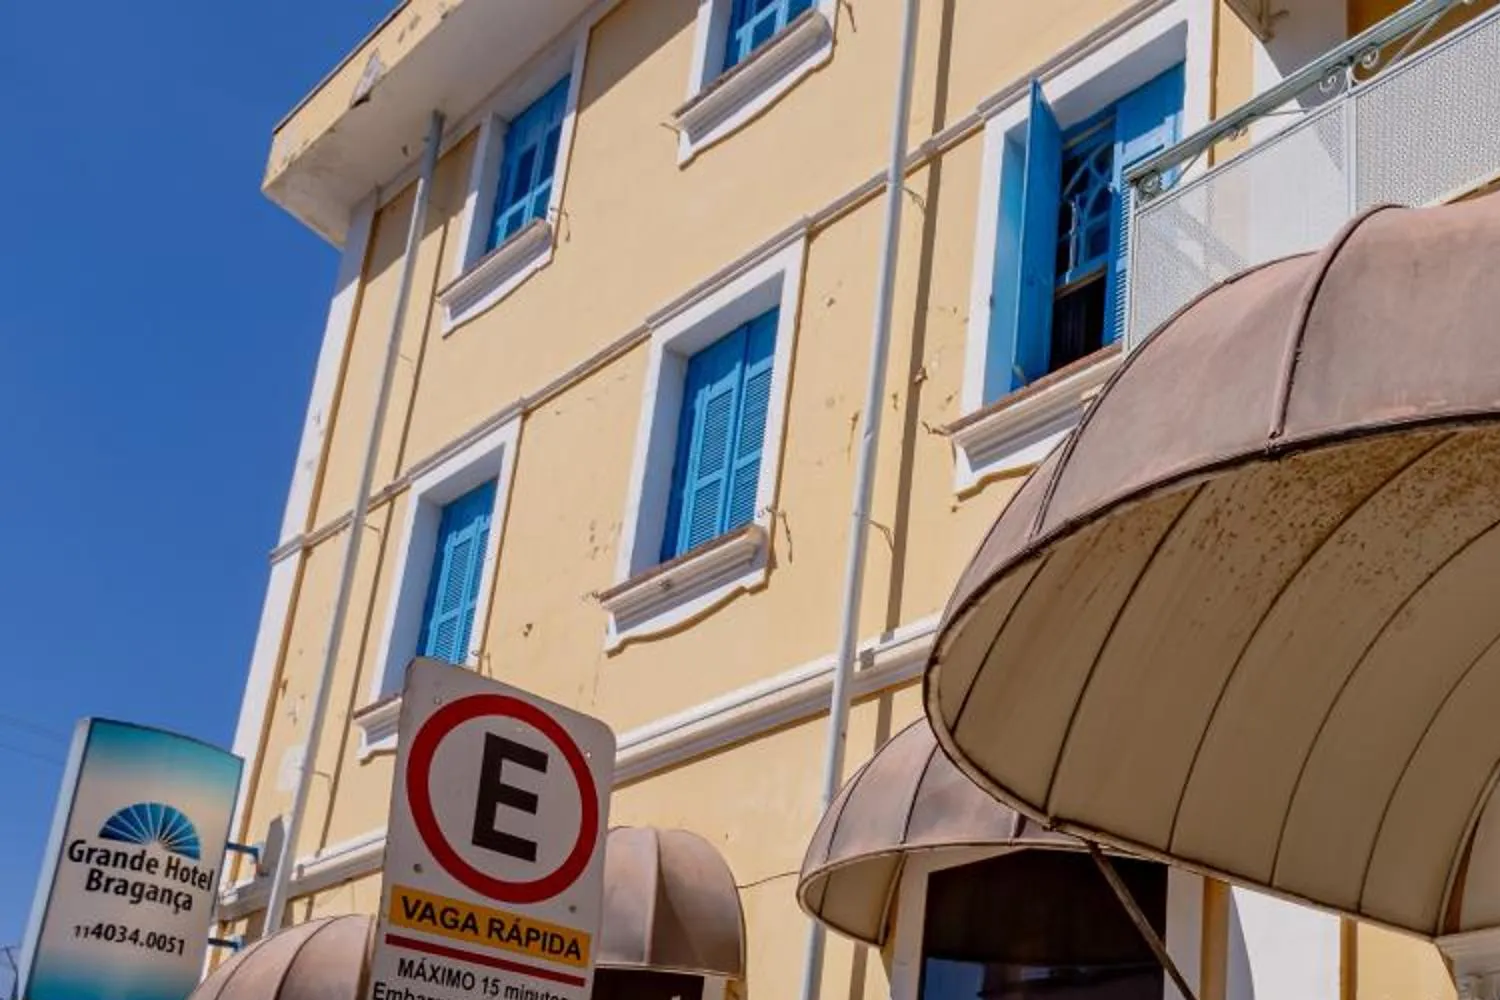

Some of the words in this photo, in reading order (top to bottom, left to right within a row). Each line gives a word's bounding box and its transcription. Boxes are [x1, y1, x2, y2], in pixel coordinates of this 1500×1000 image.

[471, 732, 548, 863] E
[67, 839, 159, 875] Grande
[165, 855, 215, 892] Hotel
[85, 868, 193, 915] Bragança
[401, 896, 479, 935] VAGA
[487, 916, 581, 960] RÁPIDA
[397, 957, 475, 991] MÁXIMO
[482, 976, 499, 996] 15
